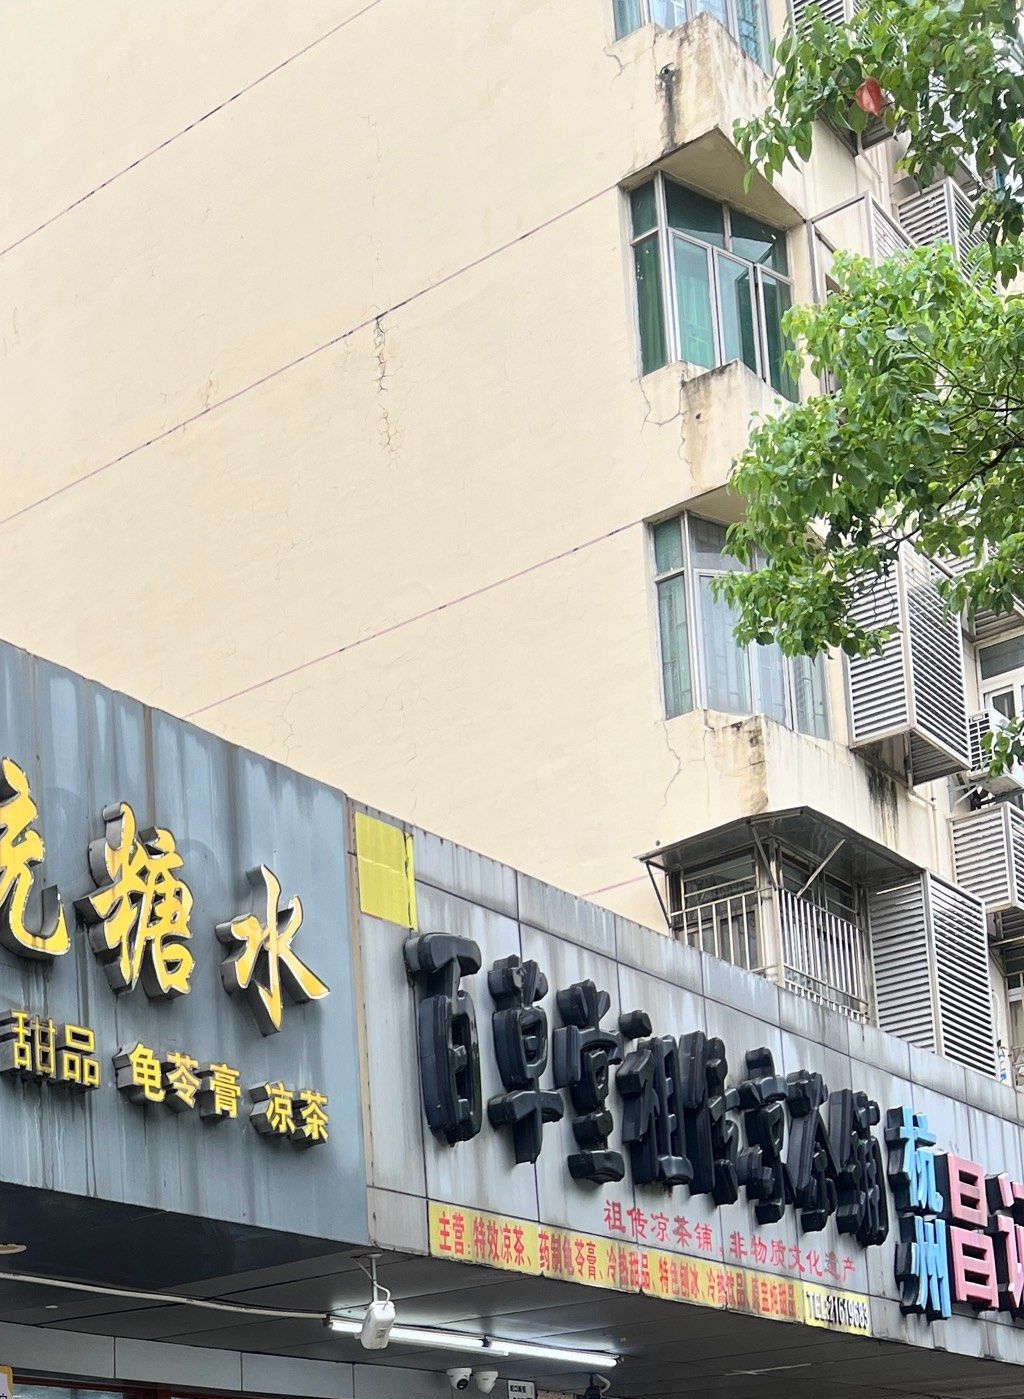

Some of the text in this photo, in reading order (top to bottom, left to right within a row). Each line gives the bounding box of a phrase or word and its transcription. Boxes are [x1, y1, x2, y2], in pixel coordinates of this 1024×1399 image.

[6, 1010, 101, 1090] 甜品
[126, 1041, 241, 1119] 龟苓膏
[260, 1080, 329, 1143] 凉茶
